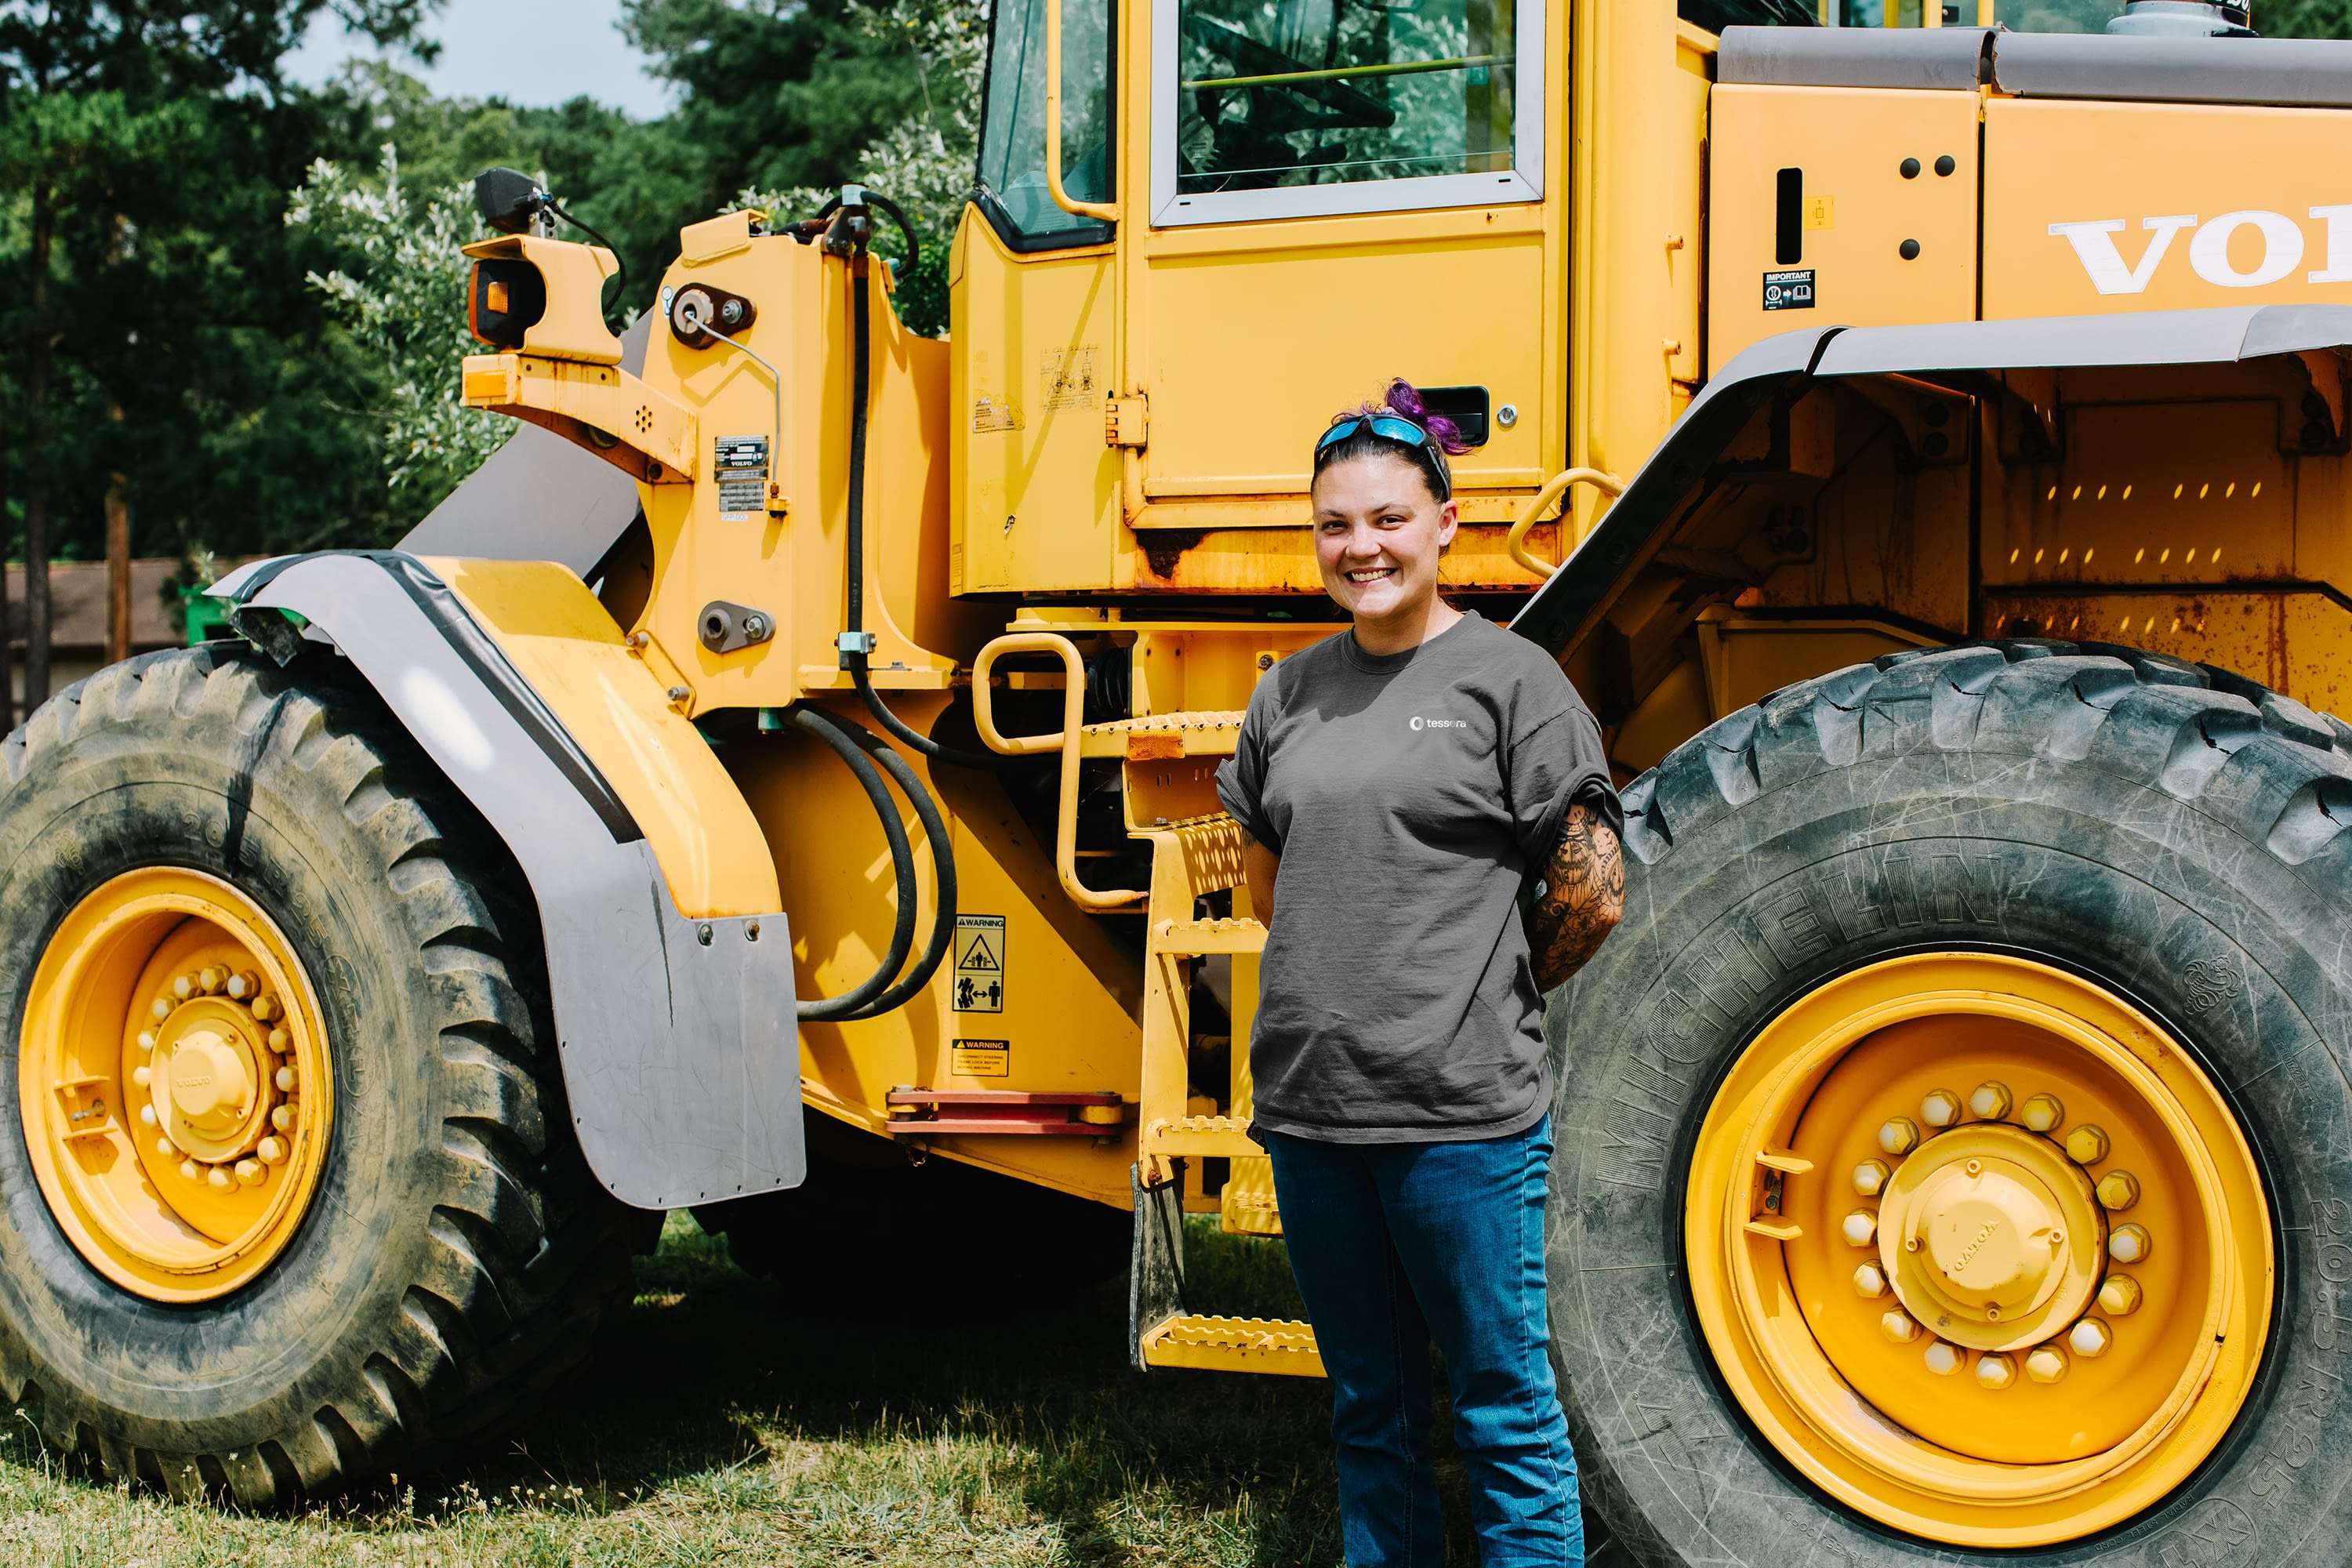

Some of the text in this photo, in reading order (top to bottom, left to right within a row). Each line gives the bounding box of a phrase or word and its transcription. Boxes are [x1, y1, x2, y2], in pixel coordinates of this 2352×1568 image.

[1766, 271, 1811, 281] IMPORTANT
[1426, 719, 1467, 728] tessera
[966, 919, 1004, 927] WARNING
[1595, 854, 2002, 1190] MICHELIN
[176, 1076, 215, 1089] VOLVO
[1954, 1220, 2000, 1272] VOLVO
[2094, 1494, 2194, 1552] RADIAL STEEL CORD
